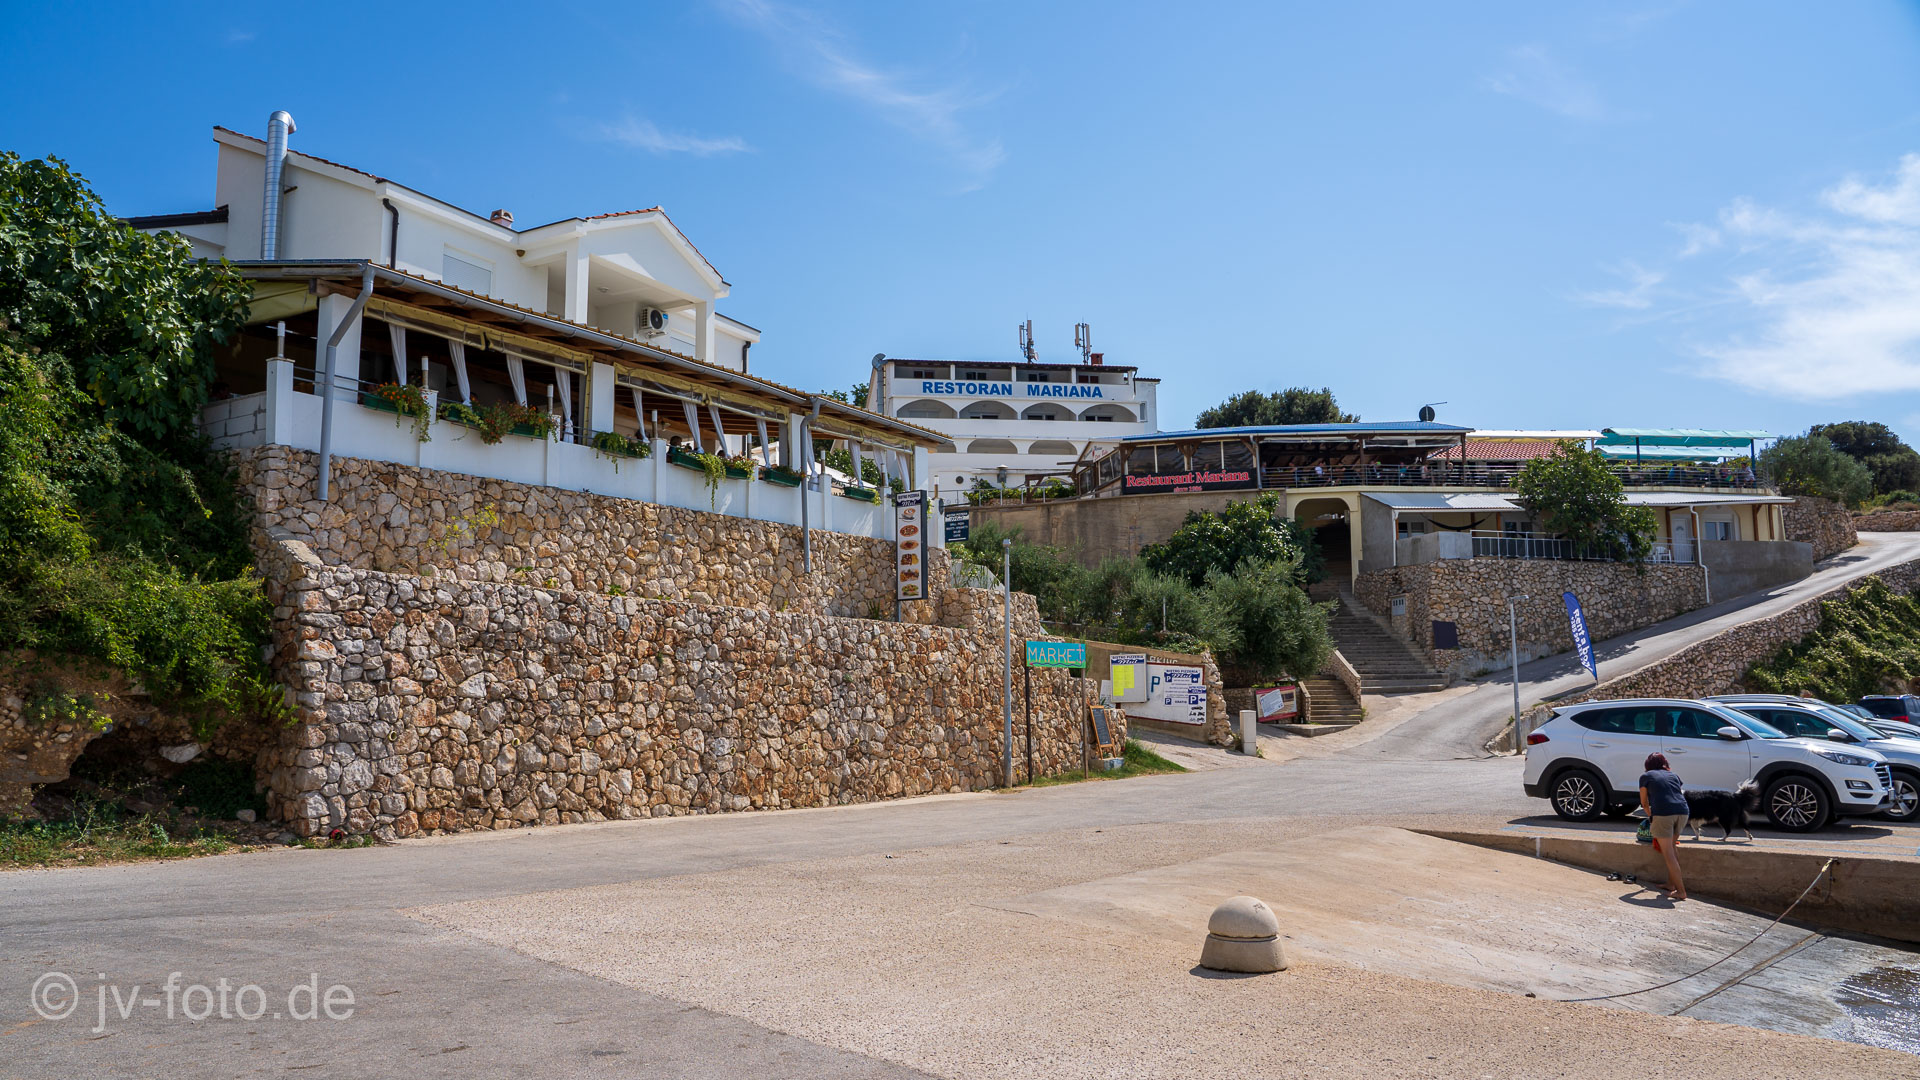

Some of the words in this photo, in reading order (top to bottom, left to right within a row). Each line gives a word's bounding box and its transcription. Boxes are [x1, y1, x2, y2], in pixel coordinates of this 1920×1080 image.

[922, 381, 1012, 395] RESTORAN
[1027, 384, 1103, 398] MARIANA
[1125, 472, 1195, 487] Restaurant
[1196, 470, 1249, 483] Mariana
[1573, 608, 1585, 636] Rent
[1028, 645, 1085, 663] MARKET
[1151, 676, 1160, 692] P
[1190, 695, 1197, 704] P
